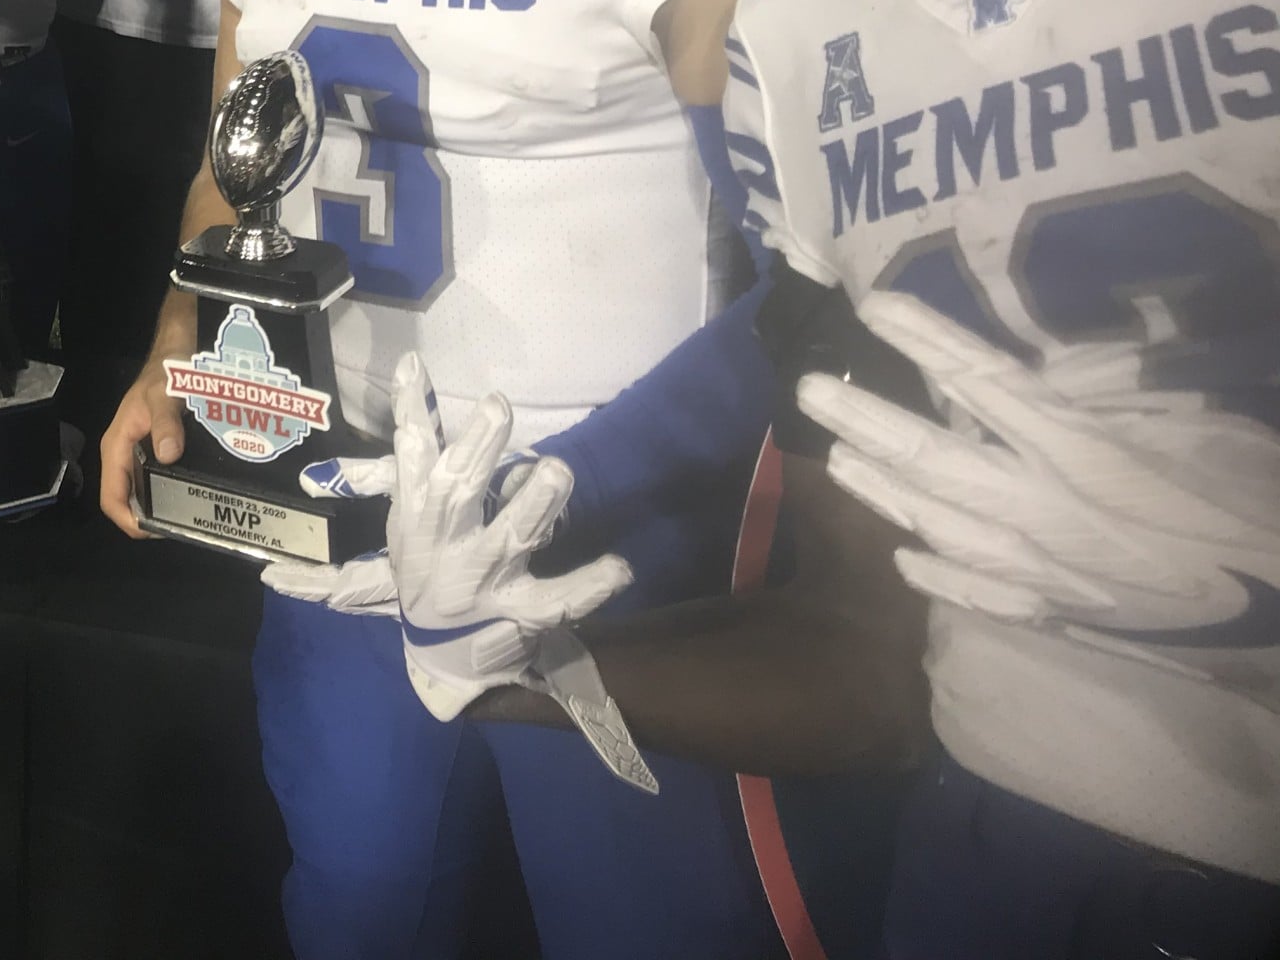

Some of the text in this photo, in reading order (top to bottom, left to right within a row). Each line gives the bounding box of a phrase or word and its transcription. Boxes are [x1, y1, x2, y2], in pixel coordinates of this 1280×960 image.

[819, 4, 1280, 239] MEMPHIS
[288, 13, 456, 312] 3
[173, 371, 321, 419] MONTGOMERY
[206, 400, 290, 438] BOWL
[232, 437, 265, 455] 2020
[187, 486, 287, 520] DECEMBER 23, 2020
[213, 504, 261, 530] MVP
[193, 516, 285, 549] MONTGOMERY, AL
